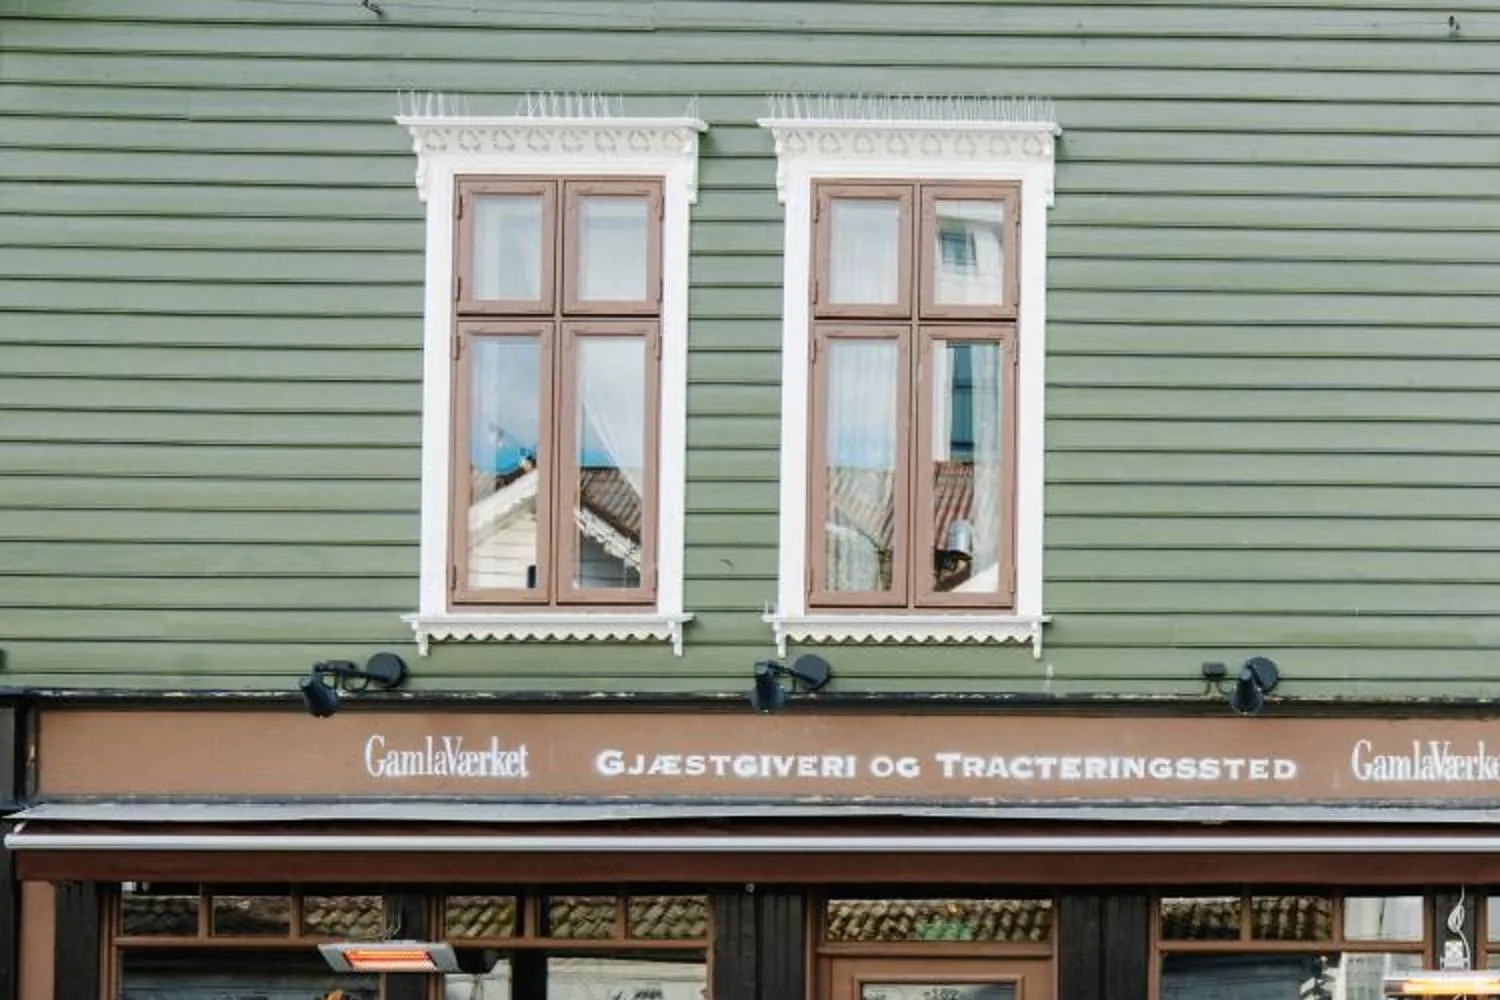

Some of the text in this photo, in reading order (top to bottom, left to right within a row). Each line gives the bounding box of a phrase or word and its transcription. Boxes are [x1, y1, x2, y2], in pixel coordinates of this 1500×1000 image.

[363, 735, 529, 778] GamlaVærket
[596, 749, 1298, 781] GJÆSTGIVERI OG TRACTERINGSSTED
